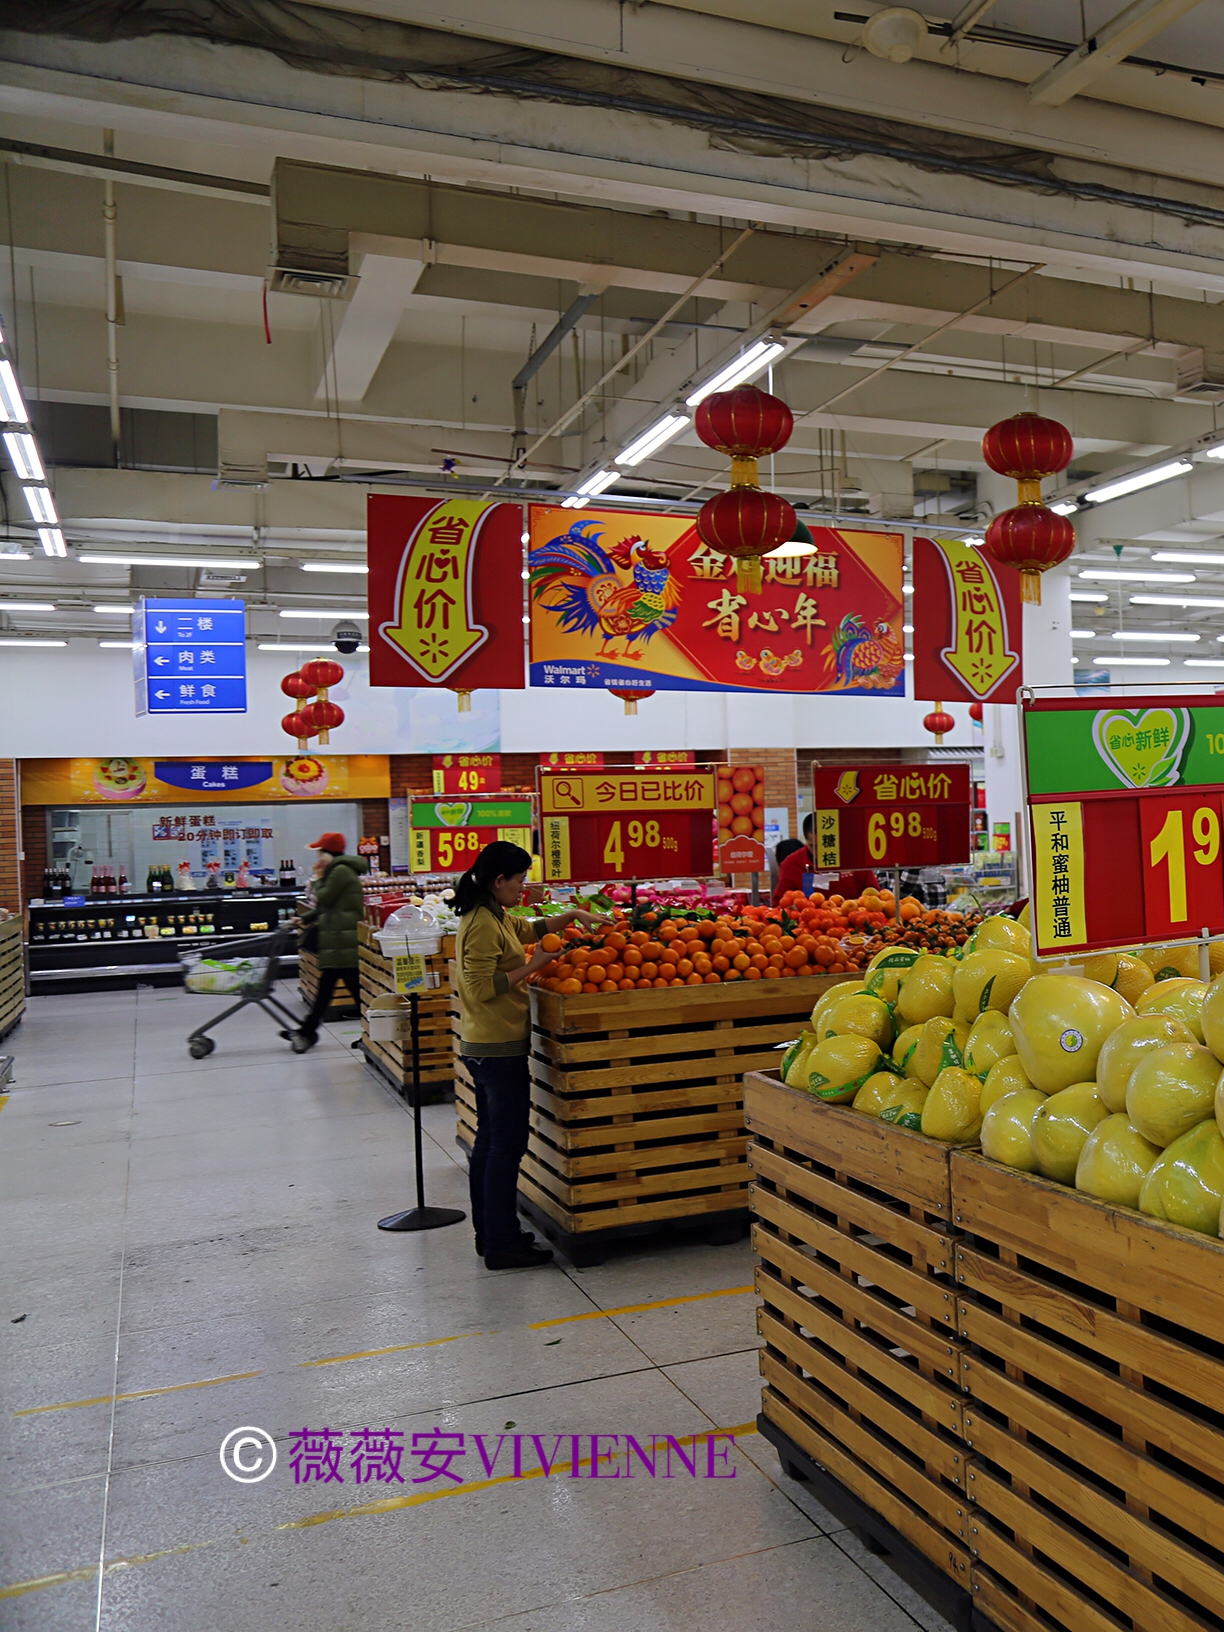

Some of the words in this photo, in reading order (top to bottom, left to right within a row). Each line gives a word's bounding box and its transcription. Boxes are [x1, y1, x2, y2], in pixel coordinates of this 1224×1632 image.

[413, 516, 470, 630] 省心价
[702, 588, 827, 645] 省心年
[955, 560, 997, 655] 省心价
[177, 617, 214, 631] 二楼
[178, 650, 216, 664] 肉类
[543, 665, 586, 675] Walmart
[544, 675, 587, 685] 沃尔玛
[179, 684, 217, 698] 鲜食
[1109, 727, 1171, 751] 省心新鲜
[190, 766, 239, 780] 蛋糕
[458, 771, 479, 791] 49
[595, 779, 705, 803] 今日已比价
[873, 772, 952, 800] 省心价
[159, 815, 216, 828] 新鲜蛋糕
[178, 828, 274, 841] 20分钟即订即取
[821, 815, 837, 867] 沙糖桔
[1049, 810, 1072, 939] 平和蜜柚普通
